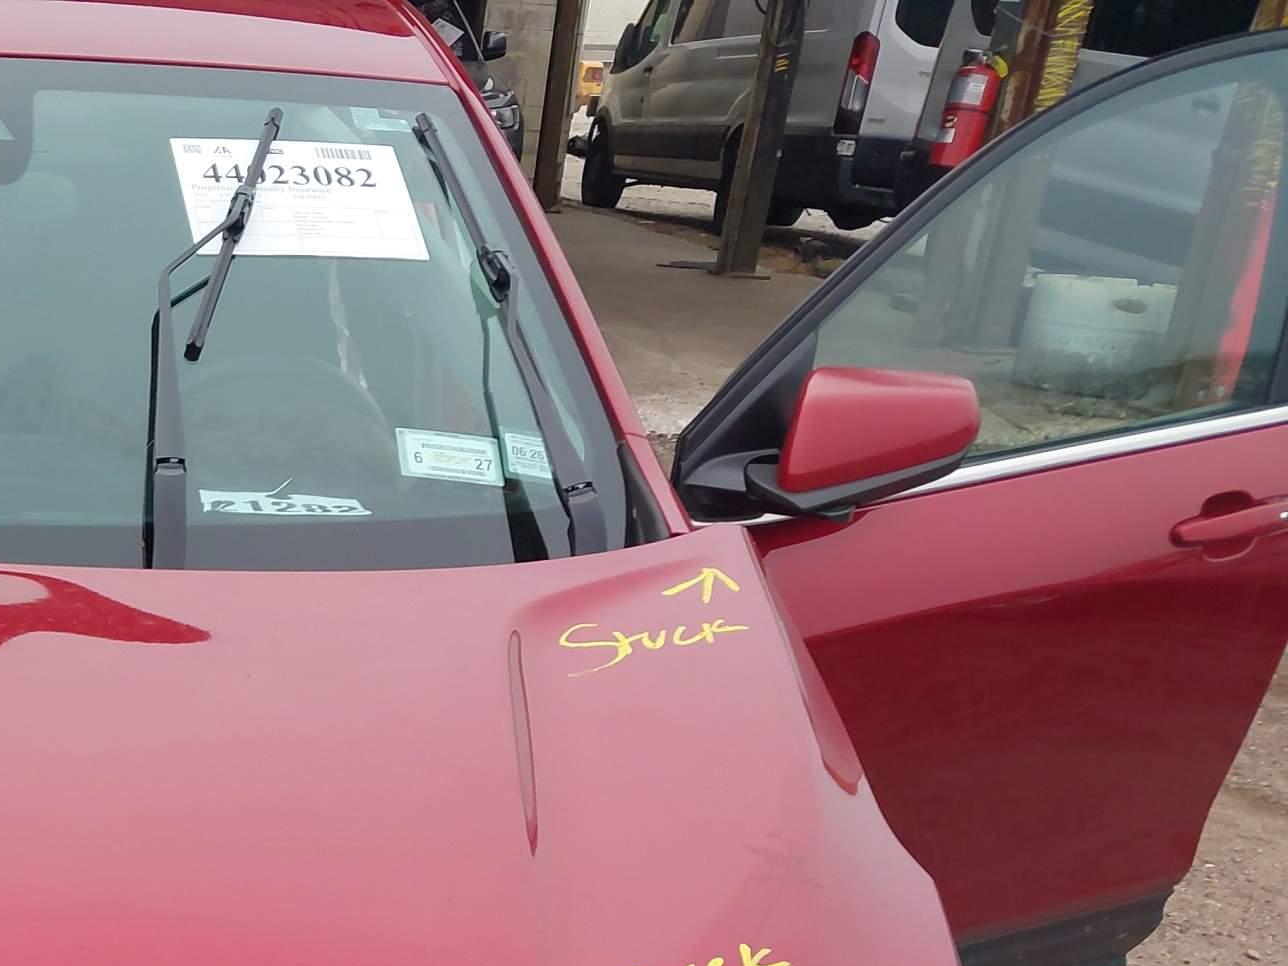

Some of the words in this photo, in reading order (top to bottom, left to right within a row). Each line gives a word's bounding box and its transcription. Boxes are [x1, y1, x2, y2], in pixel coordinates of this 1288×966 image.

[202, 162, 377, 188] 4423082
[413, 451, 424, 464] 6
[474, 458, 492, 471] 27
